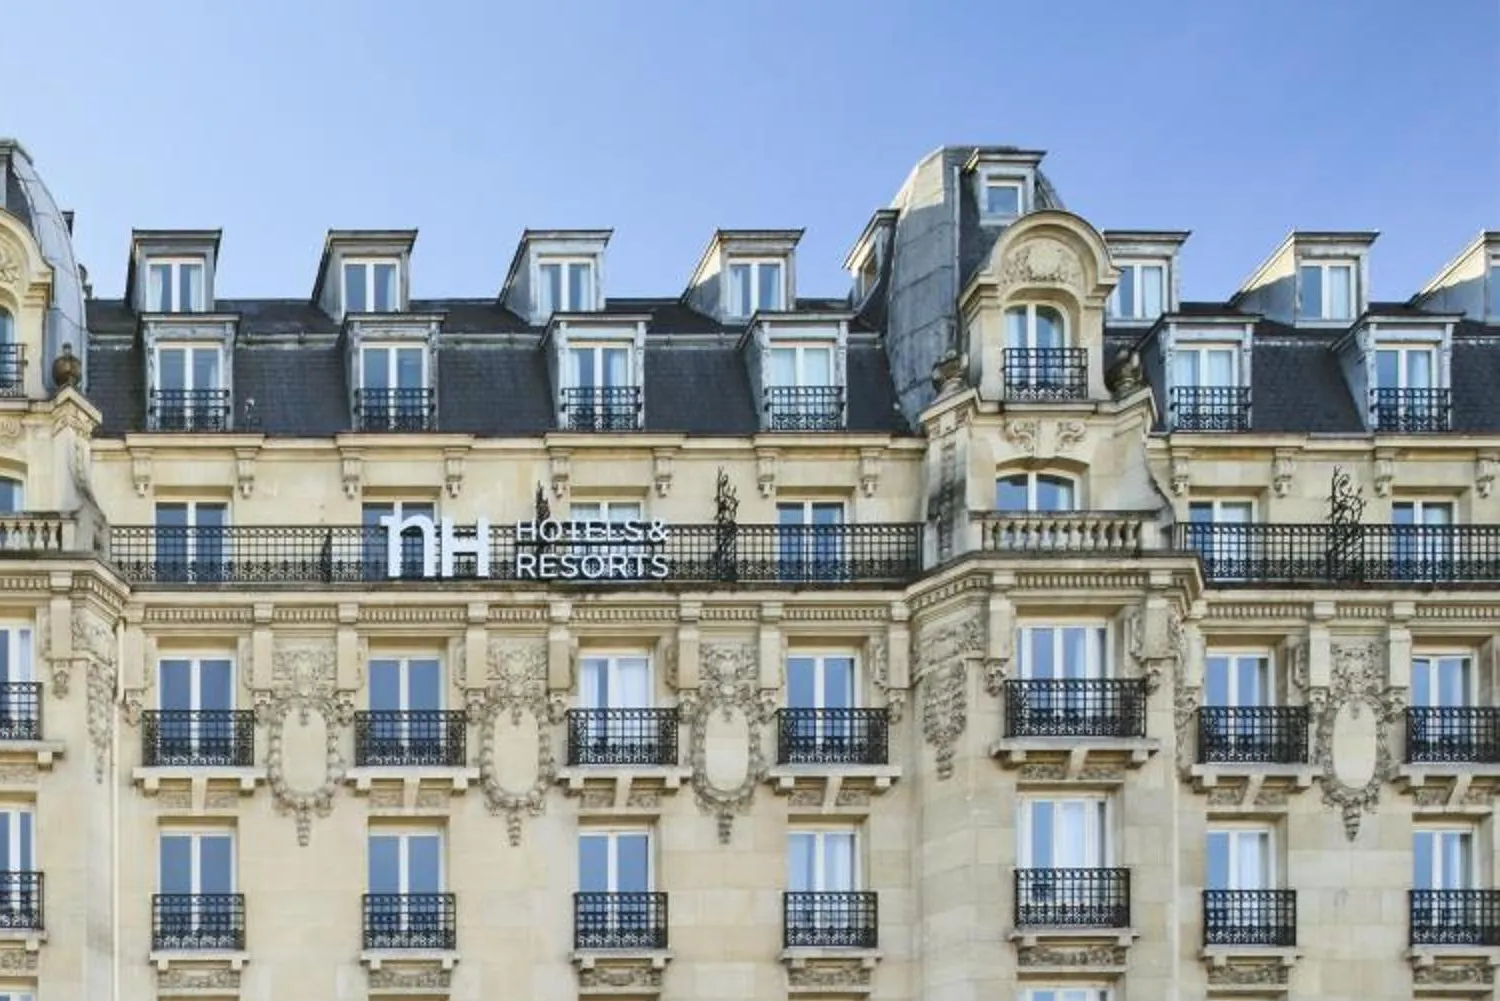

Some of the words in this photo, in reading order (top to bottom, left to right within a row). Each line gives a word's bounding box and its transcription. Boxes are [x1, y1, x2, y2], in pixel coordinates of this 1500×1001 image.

[516, 518, 643, 542] HOTELS
[649, 518, 670, 542] &
[516, 553, 669, 578] RESORTS
